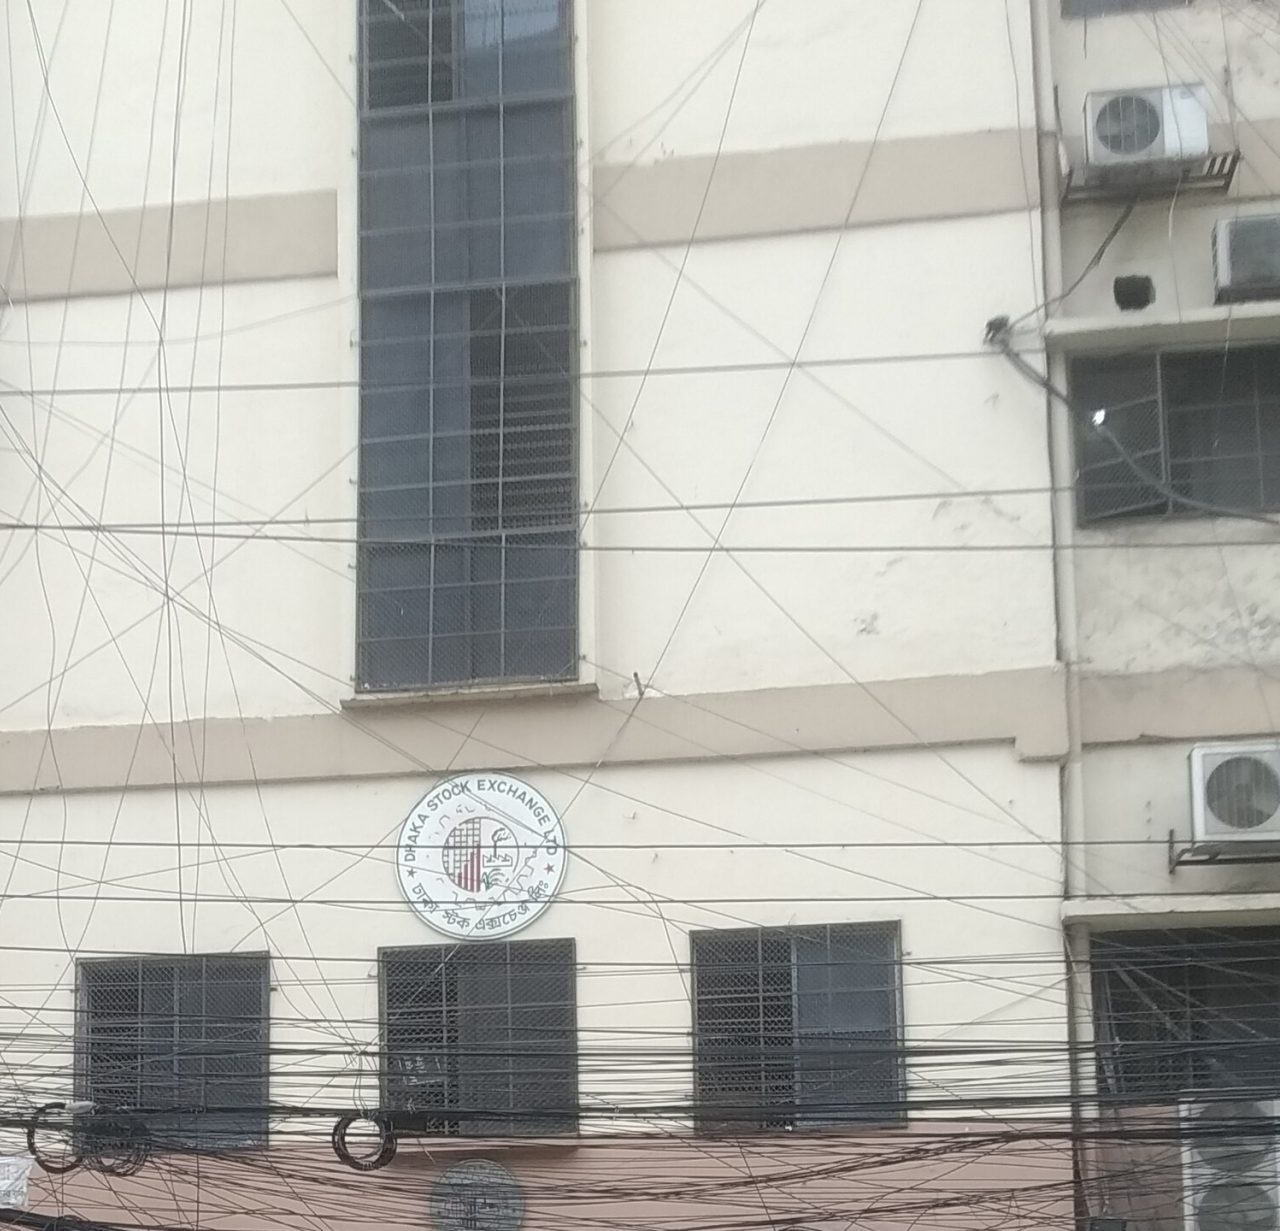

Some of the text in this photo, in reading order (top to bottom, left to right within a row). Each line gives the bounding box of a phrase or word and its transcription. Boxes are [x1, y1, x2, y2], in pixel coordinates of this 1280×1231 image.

[404, 779, 558, 862] DHAKA STOCK EXCHANGE LTD
[412, 883, 439, 914] ঢাকা
